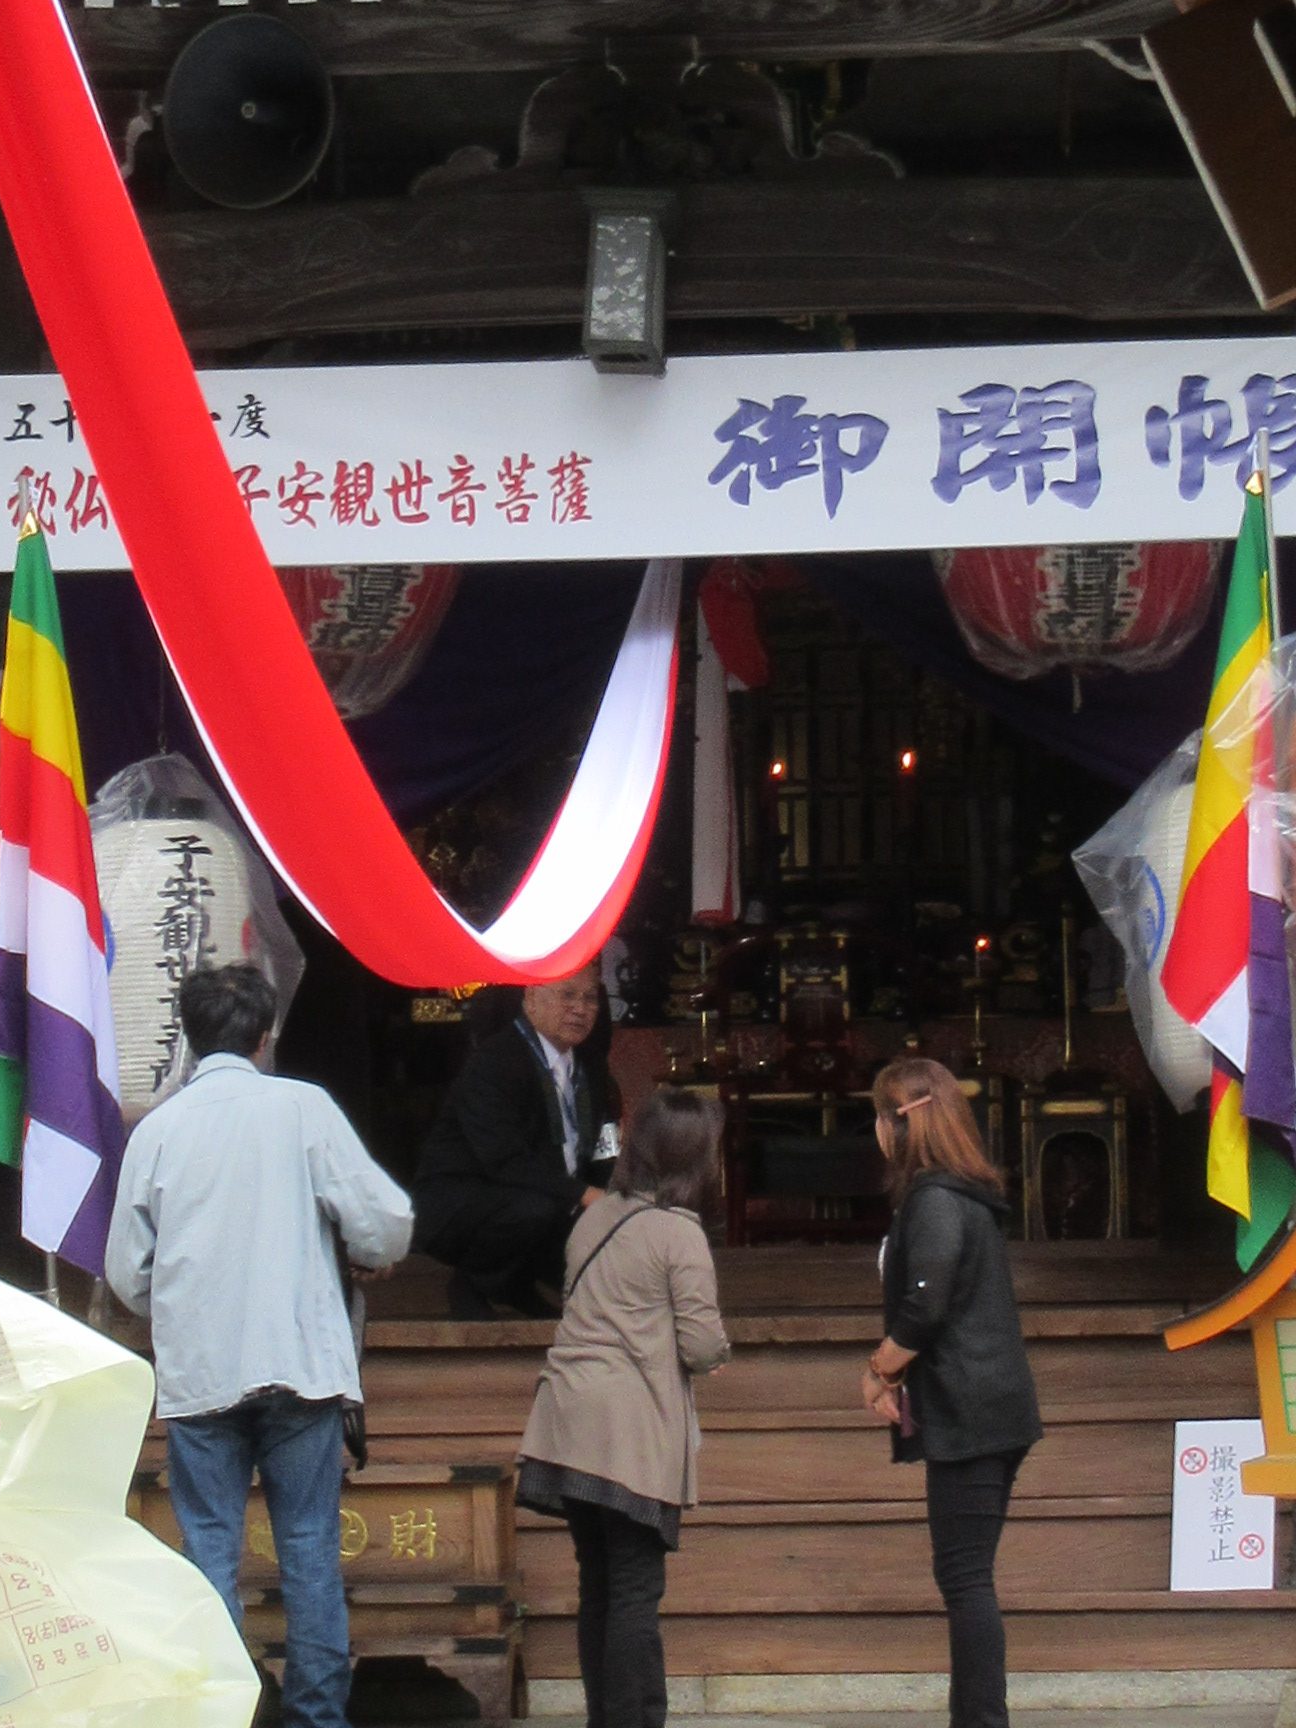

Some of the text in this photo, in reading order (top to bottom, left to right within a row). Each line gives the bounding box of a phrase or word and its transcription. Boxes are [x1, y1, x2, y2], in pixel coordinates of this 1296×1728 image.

[7, 450, 594, 537] 秘仏子安観世音菩薩
[1207, 1445, 1239, 1564] 撮影禁止
